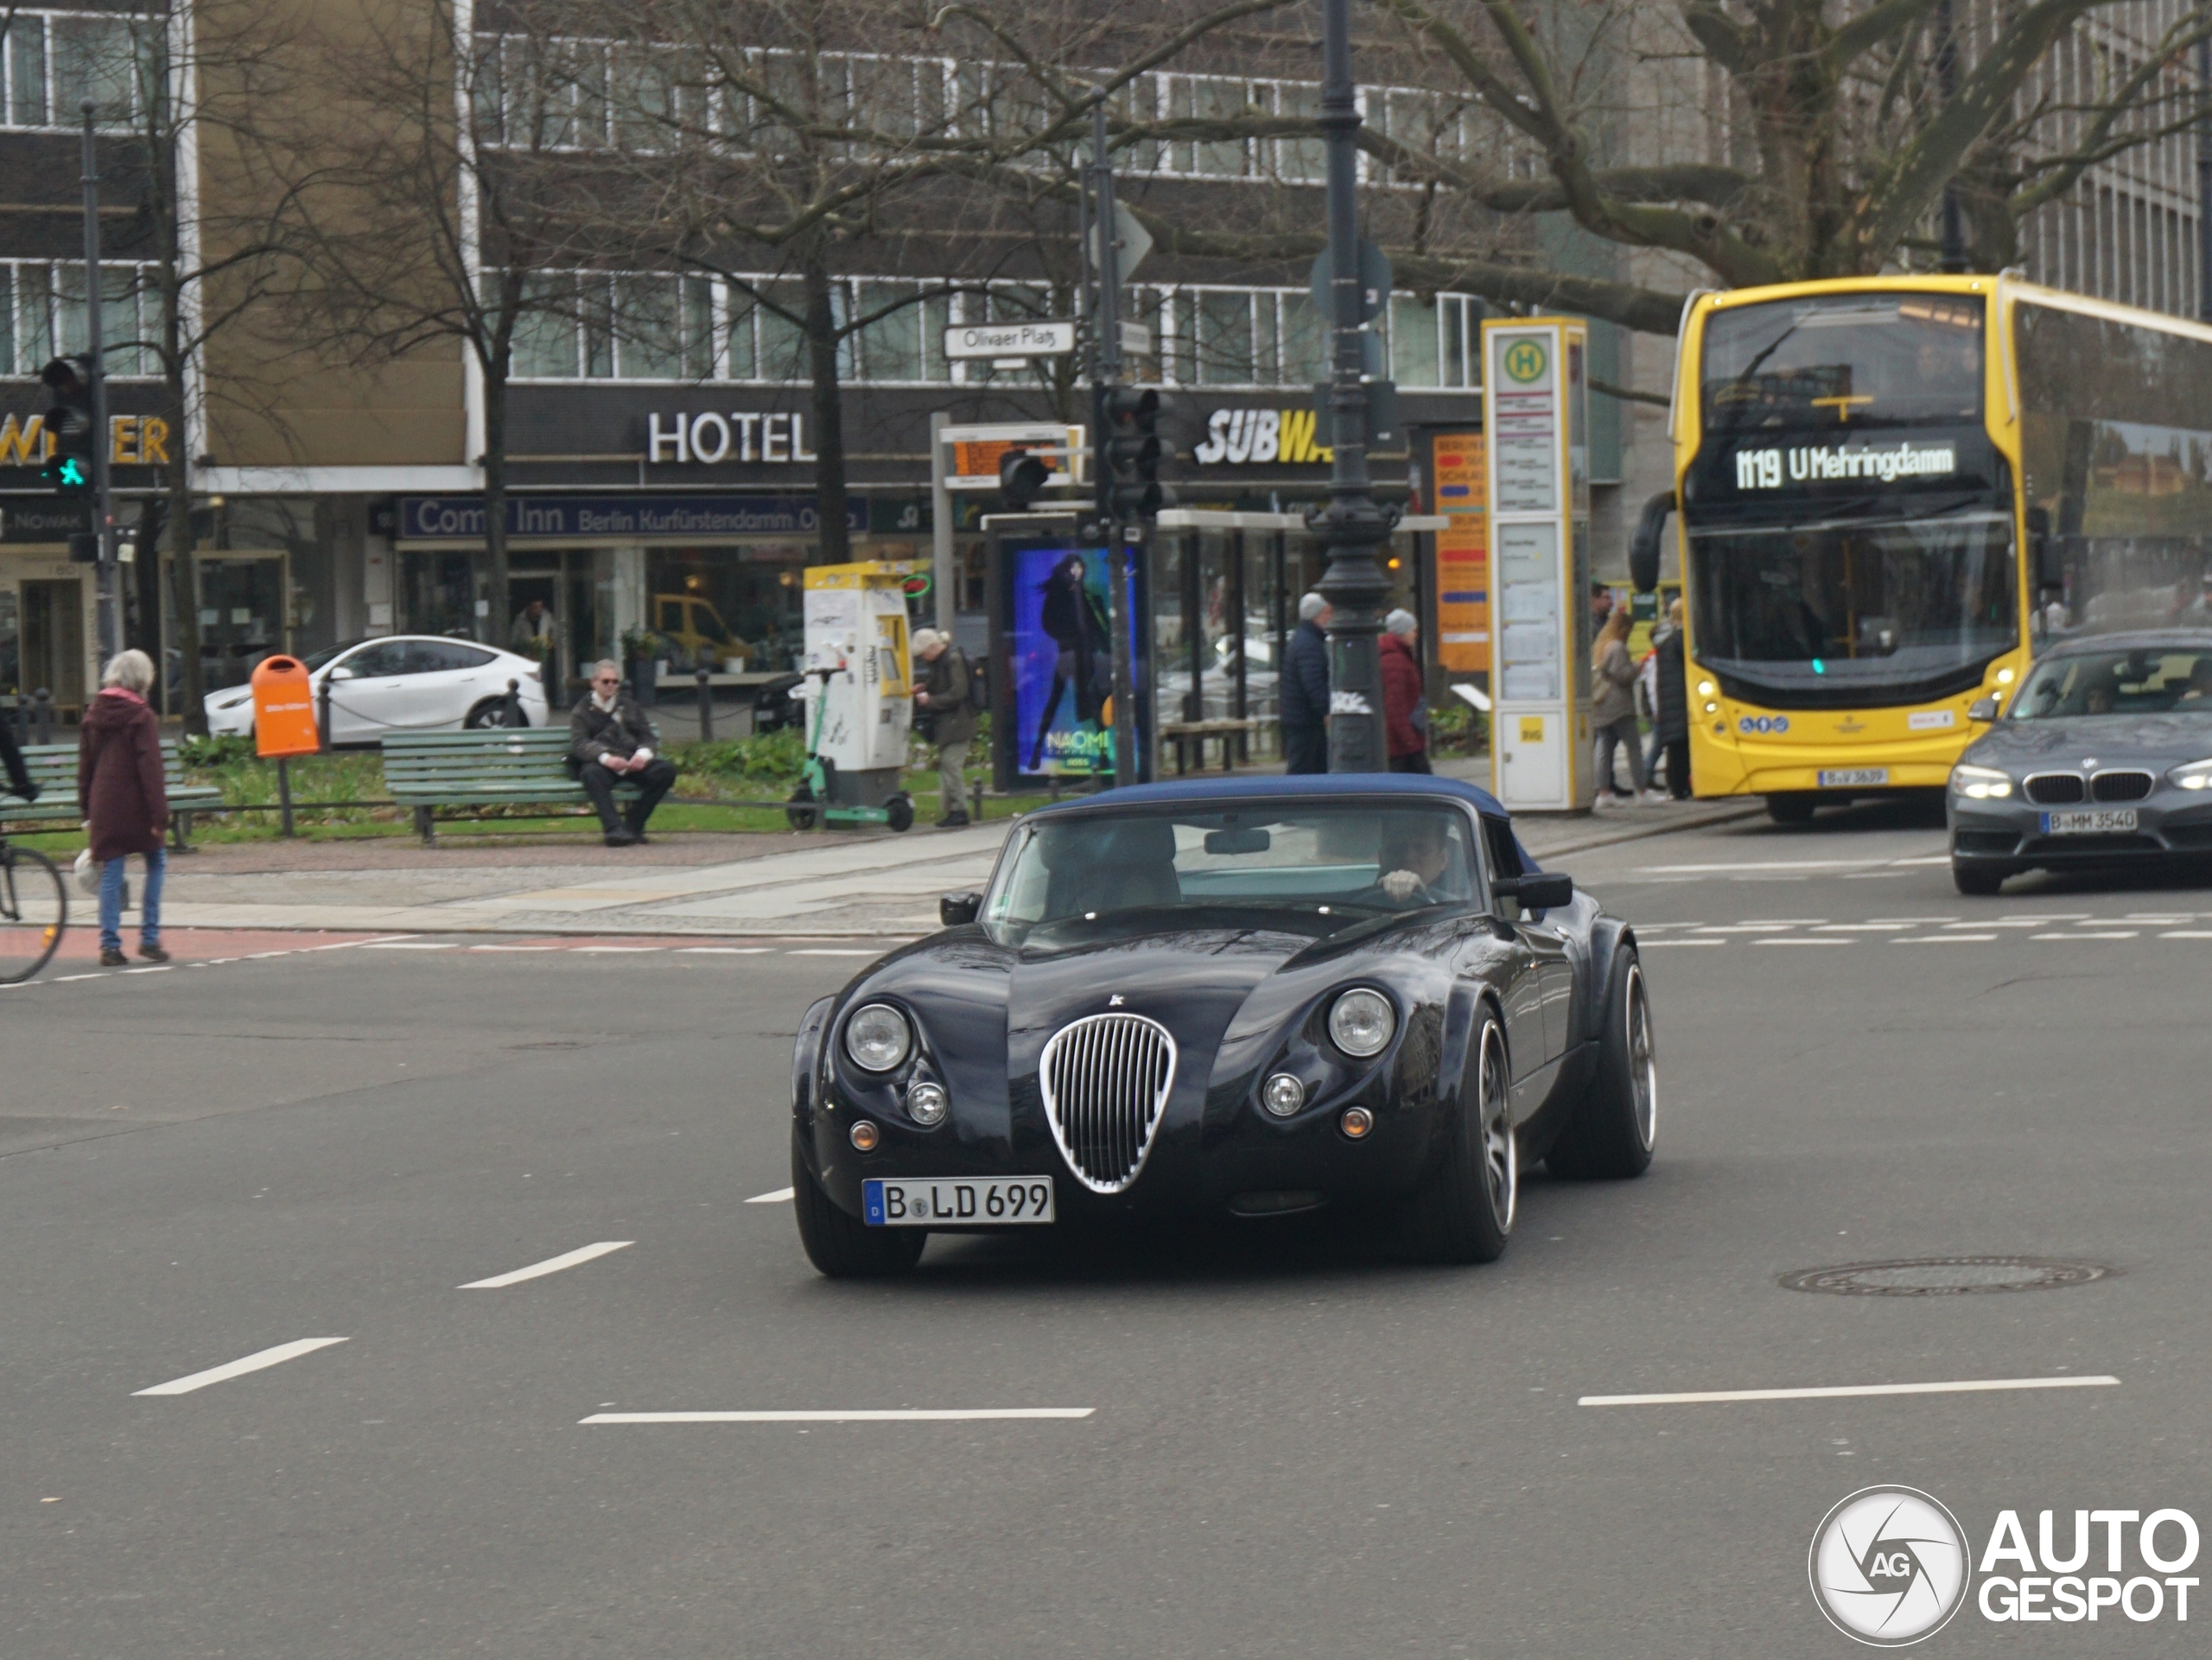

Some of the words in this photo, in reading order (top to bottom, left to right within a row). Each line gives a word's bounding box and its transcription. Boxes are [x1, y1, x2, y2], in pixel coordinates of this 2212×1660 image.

[964, 329, 1019, 347] Olivaer
[1516, 349, 1535, 373] H
[648, 410, 817, 464] HOTEL
[1736, 448, 1782, 490] M19
[1789, 446, 1808, 480] U
[1810, 441, 1955, 482] Mehringdamm
[416, 499, 486, 534] Com
[517, 499, 563, 533] Inn
[577, 509, 634, 531] Berlin
[639, 507, 794, 531] Kurfürstendamm
[1046, 730, 1109, 749] NAOMI
[2050, 815, 2060, 830] B
[2072, 813, 2092, 829] MM
[2095, 811, 2135, 829] 3540
[886, 1186, 906, 1218] B
[931, 1185, 976, 1218] LD
[985, 1184, 1048, 1218] 699
